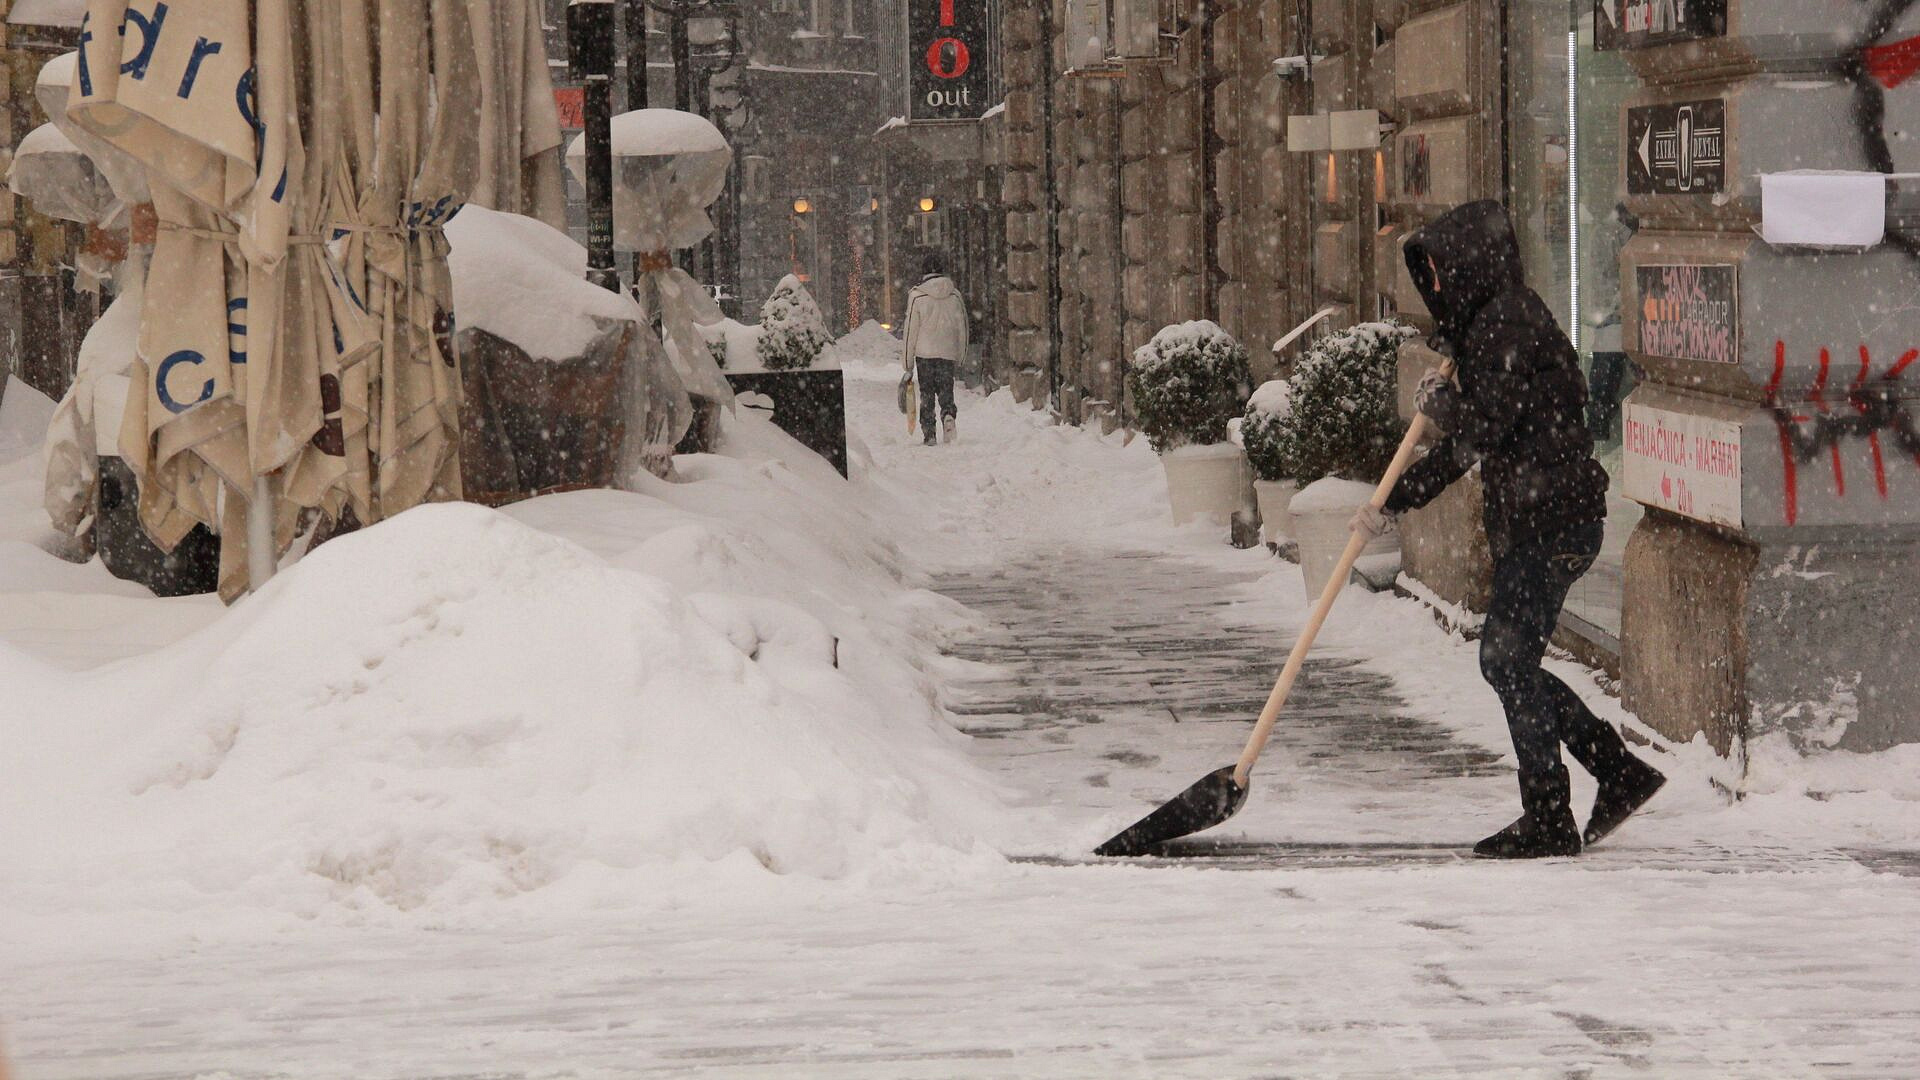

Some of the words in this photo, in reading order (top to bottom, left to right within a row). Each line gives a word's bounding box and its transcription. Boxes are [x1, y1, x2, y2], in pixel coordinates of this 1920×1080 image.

[926, 86, 971, 107] out
[1655, 139, 1677, 160] EXTRA
[1693, 136, 1721, 158] DENTAL
[1682, 299, 1729, 325] LABRADOR
[1626, 417, 1687, 468] MENJAČNICA
[1696, 436, 1739, 480] MARMAT
